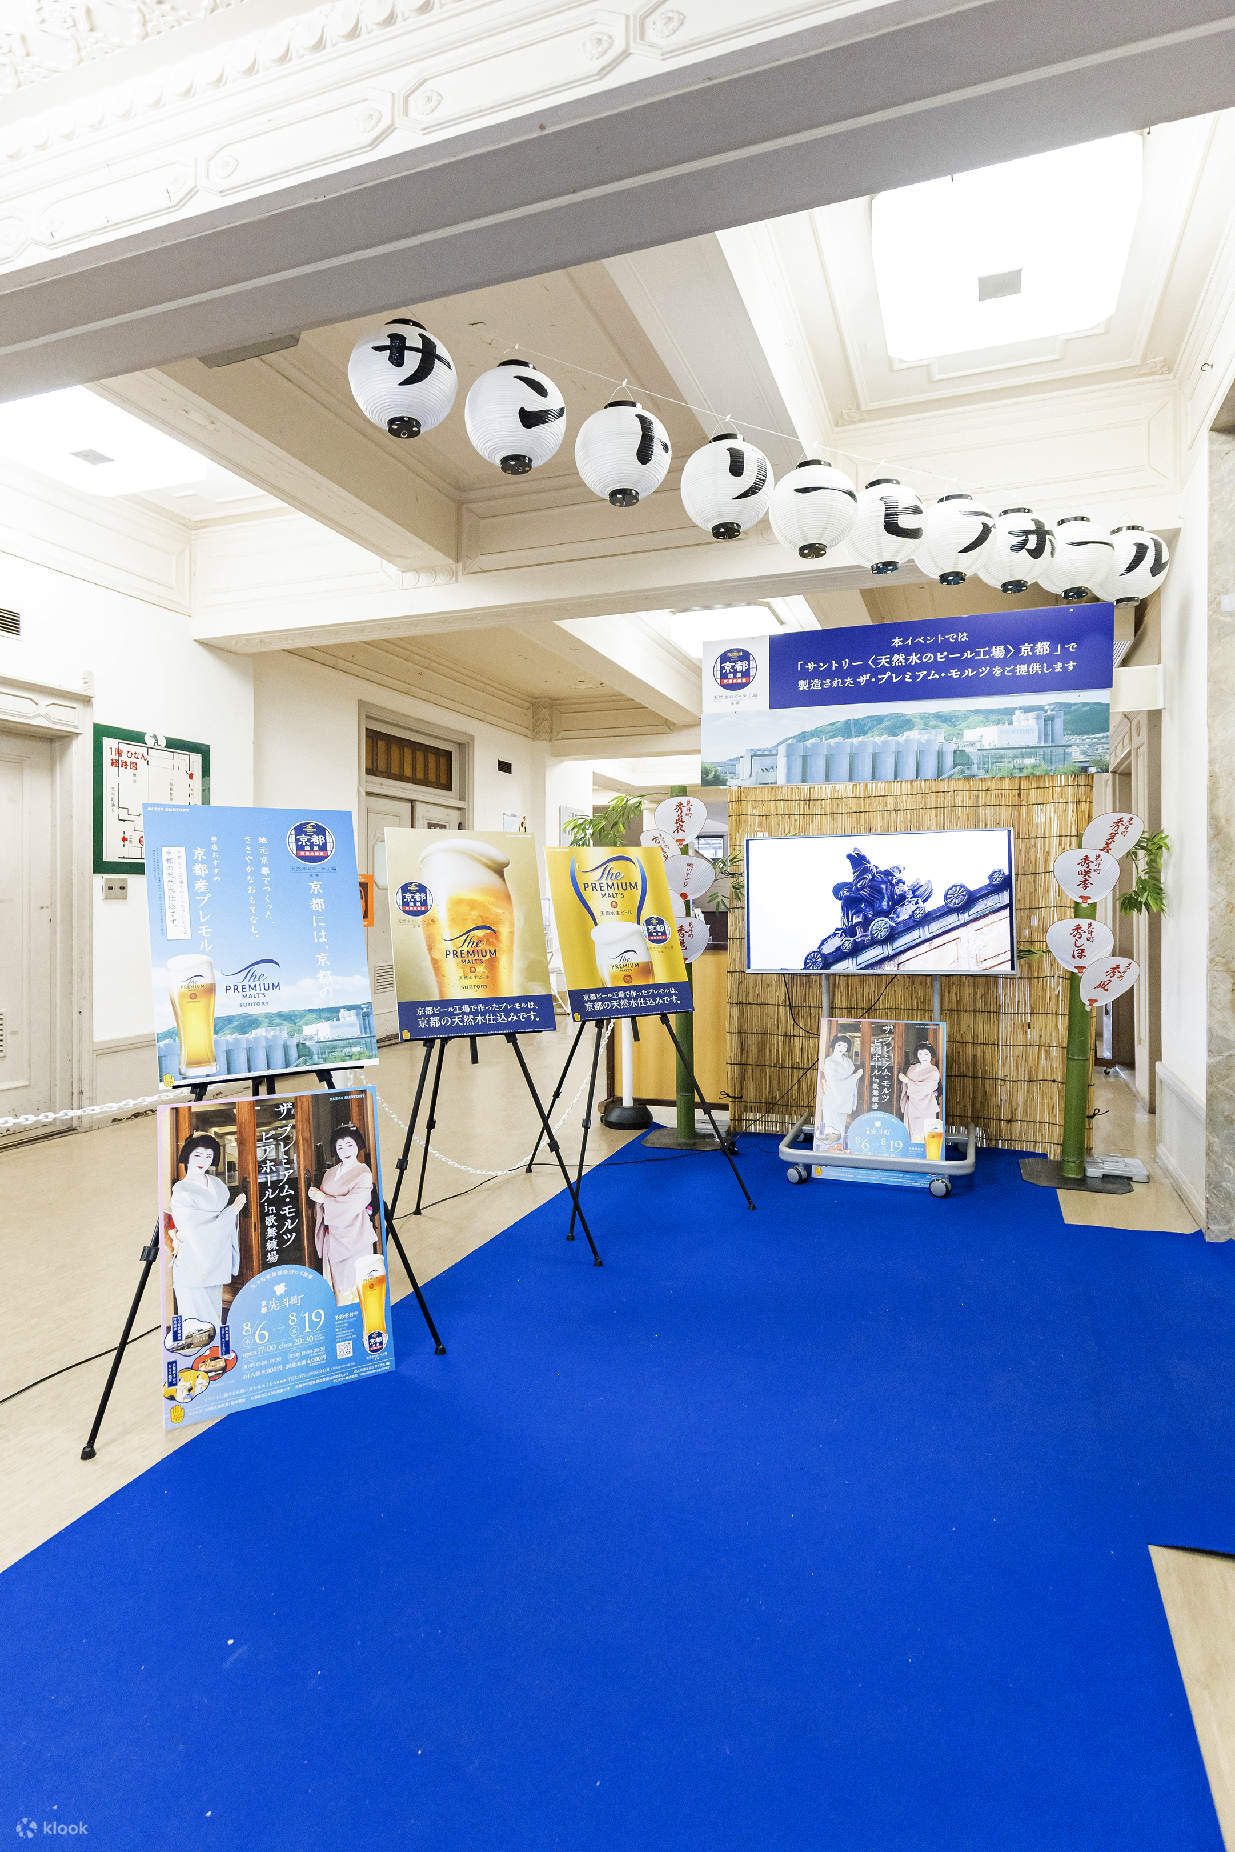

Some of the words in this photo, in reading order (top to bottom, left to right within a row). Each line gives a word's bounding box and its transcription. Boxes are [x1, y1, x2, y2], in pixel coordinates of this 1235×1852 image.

[890, 631, 969, 648] 本イベントでは
[720, 661, 749, 674] 京都
[296, 835, 326, 846] 京都
[583, 881, 639, 892] PREMIUM
[191, 846, 215, 952] 京都産プレモル
[445, 949, 497, 959] PREMIUM
[225, 982, 281, 994] PREMIUM
[584, 995, 681, 1012] 京都の天然水仕込みです。
[417, 1010, 541, 1029] 京都の天然水仕込みです。
[274, 1102, 299, 1248] ザ・プレミアム・モルツ
